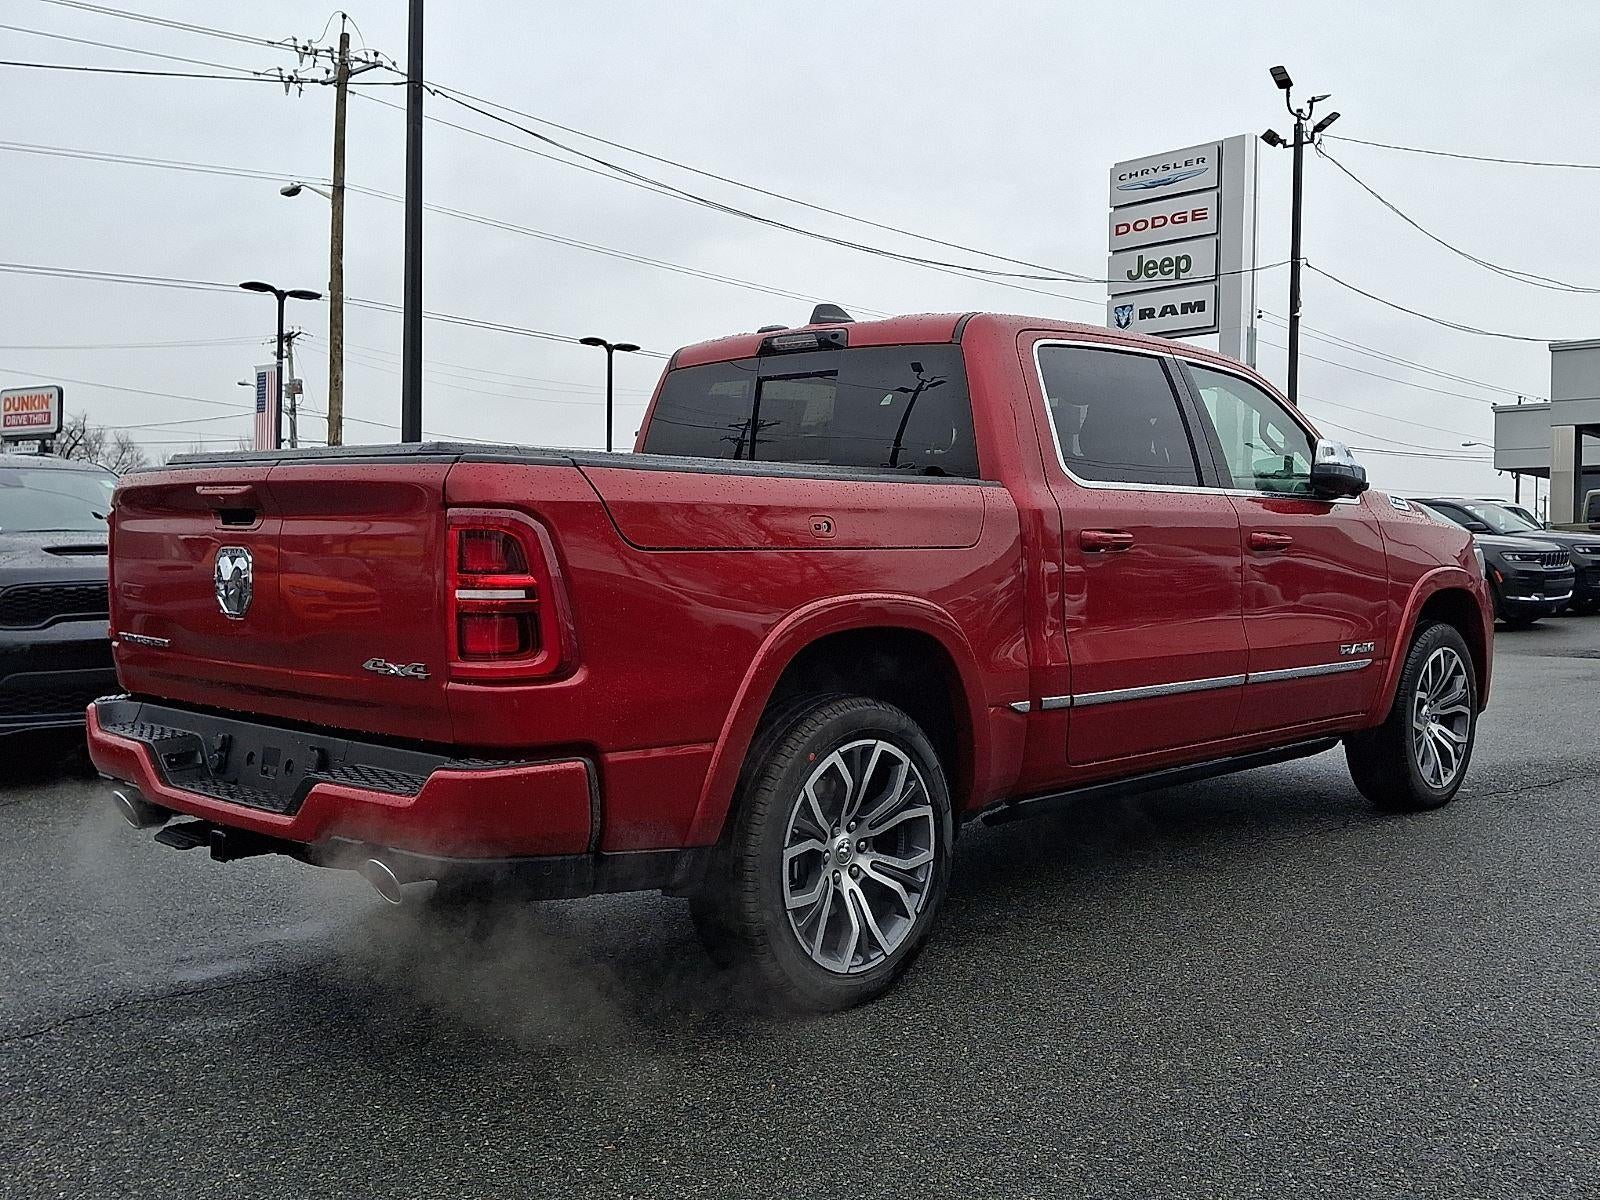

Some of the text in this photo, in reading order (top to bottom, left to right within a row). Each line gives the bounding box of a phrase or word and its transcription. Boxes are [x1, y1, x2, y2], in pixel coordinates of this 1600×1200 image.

[1118, 157, 1207, 182] CHRYSLER
[1115, 207, 1209, 236] DODGE
[1126, 254, 1192, 281] Jeep
[1138, 300, 1206, 320] RAM
[3, 393, 53, 412] DUNKIN'
[5, 413, 48, 426] DRIVE THRU
